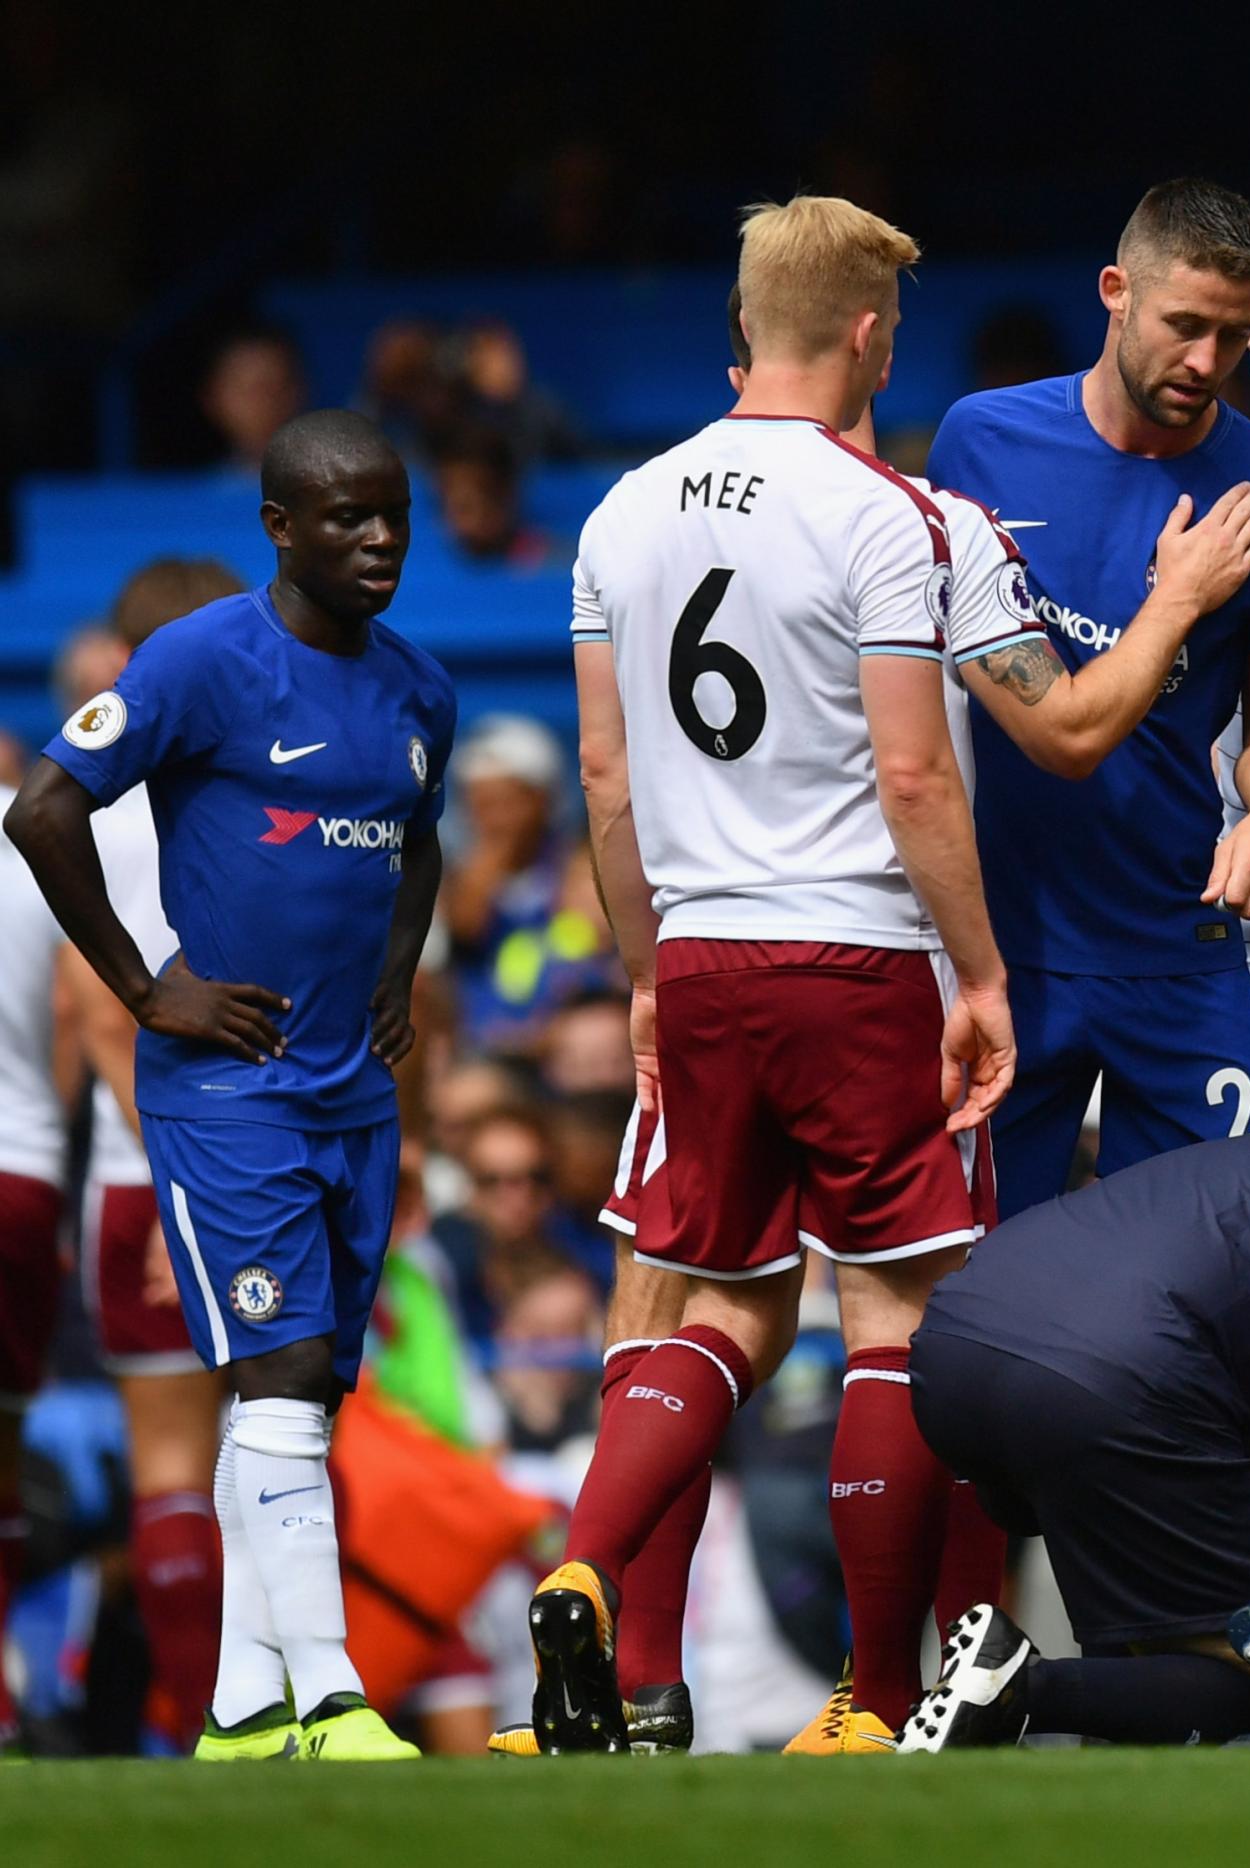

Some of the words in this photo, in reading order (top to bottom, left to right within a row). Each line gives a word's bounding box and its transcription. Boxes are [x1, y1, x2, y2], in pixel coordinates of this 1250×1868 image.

[681, 472, 765, 515] MEE
[668, 567, 768, 762] 6
[625, 1385, 685, 1413] BFC
[831, 1479, 886, 1499] BFC
